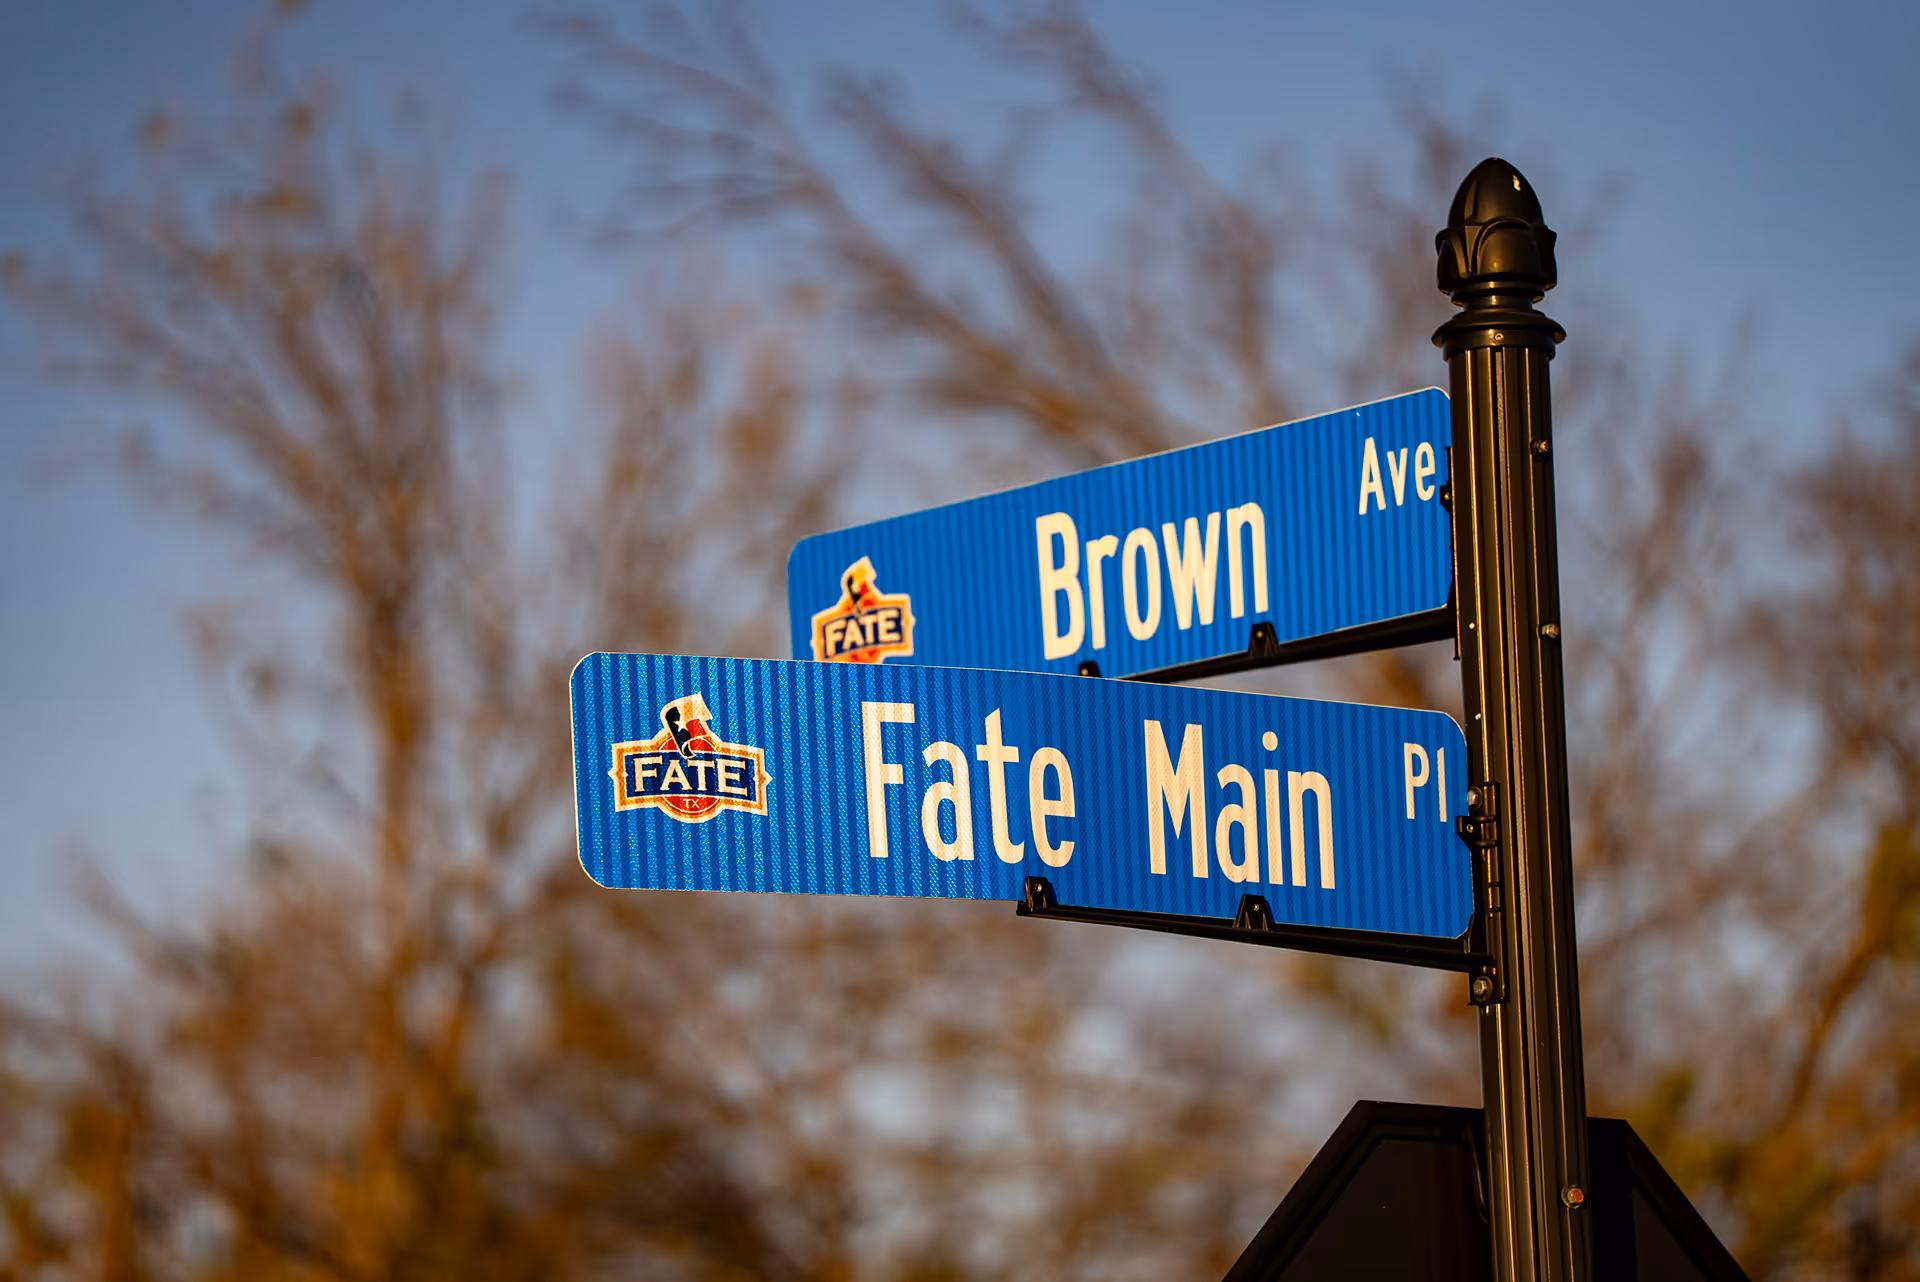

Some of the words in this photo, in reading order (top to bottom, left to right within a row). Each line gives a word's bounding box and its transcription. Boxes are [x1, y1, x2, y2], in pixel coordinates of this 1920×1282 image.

[1035, 502, 1269, 660] Brown
[1358, 437, 1436, 515] Ave
[824, 608, 901, 657] FATE
[633, 756, 748, 796] FATE
[861, 701, 1076, 868] Fate
[1143, 719, 1336, 890] Main
[1403, 742, 1448, 823] Pl
[682, 799, 700, 809] TX
